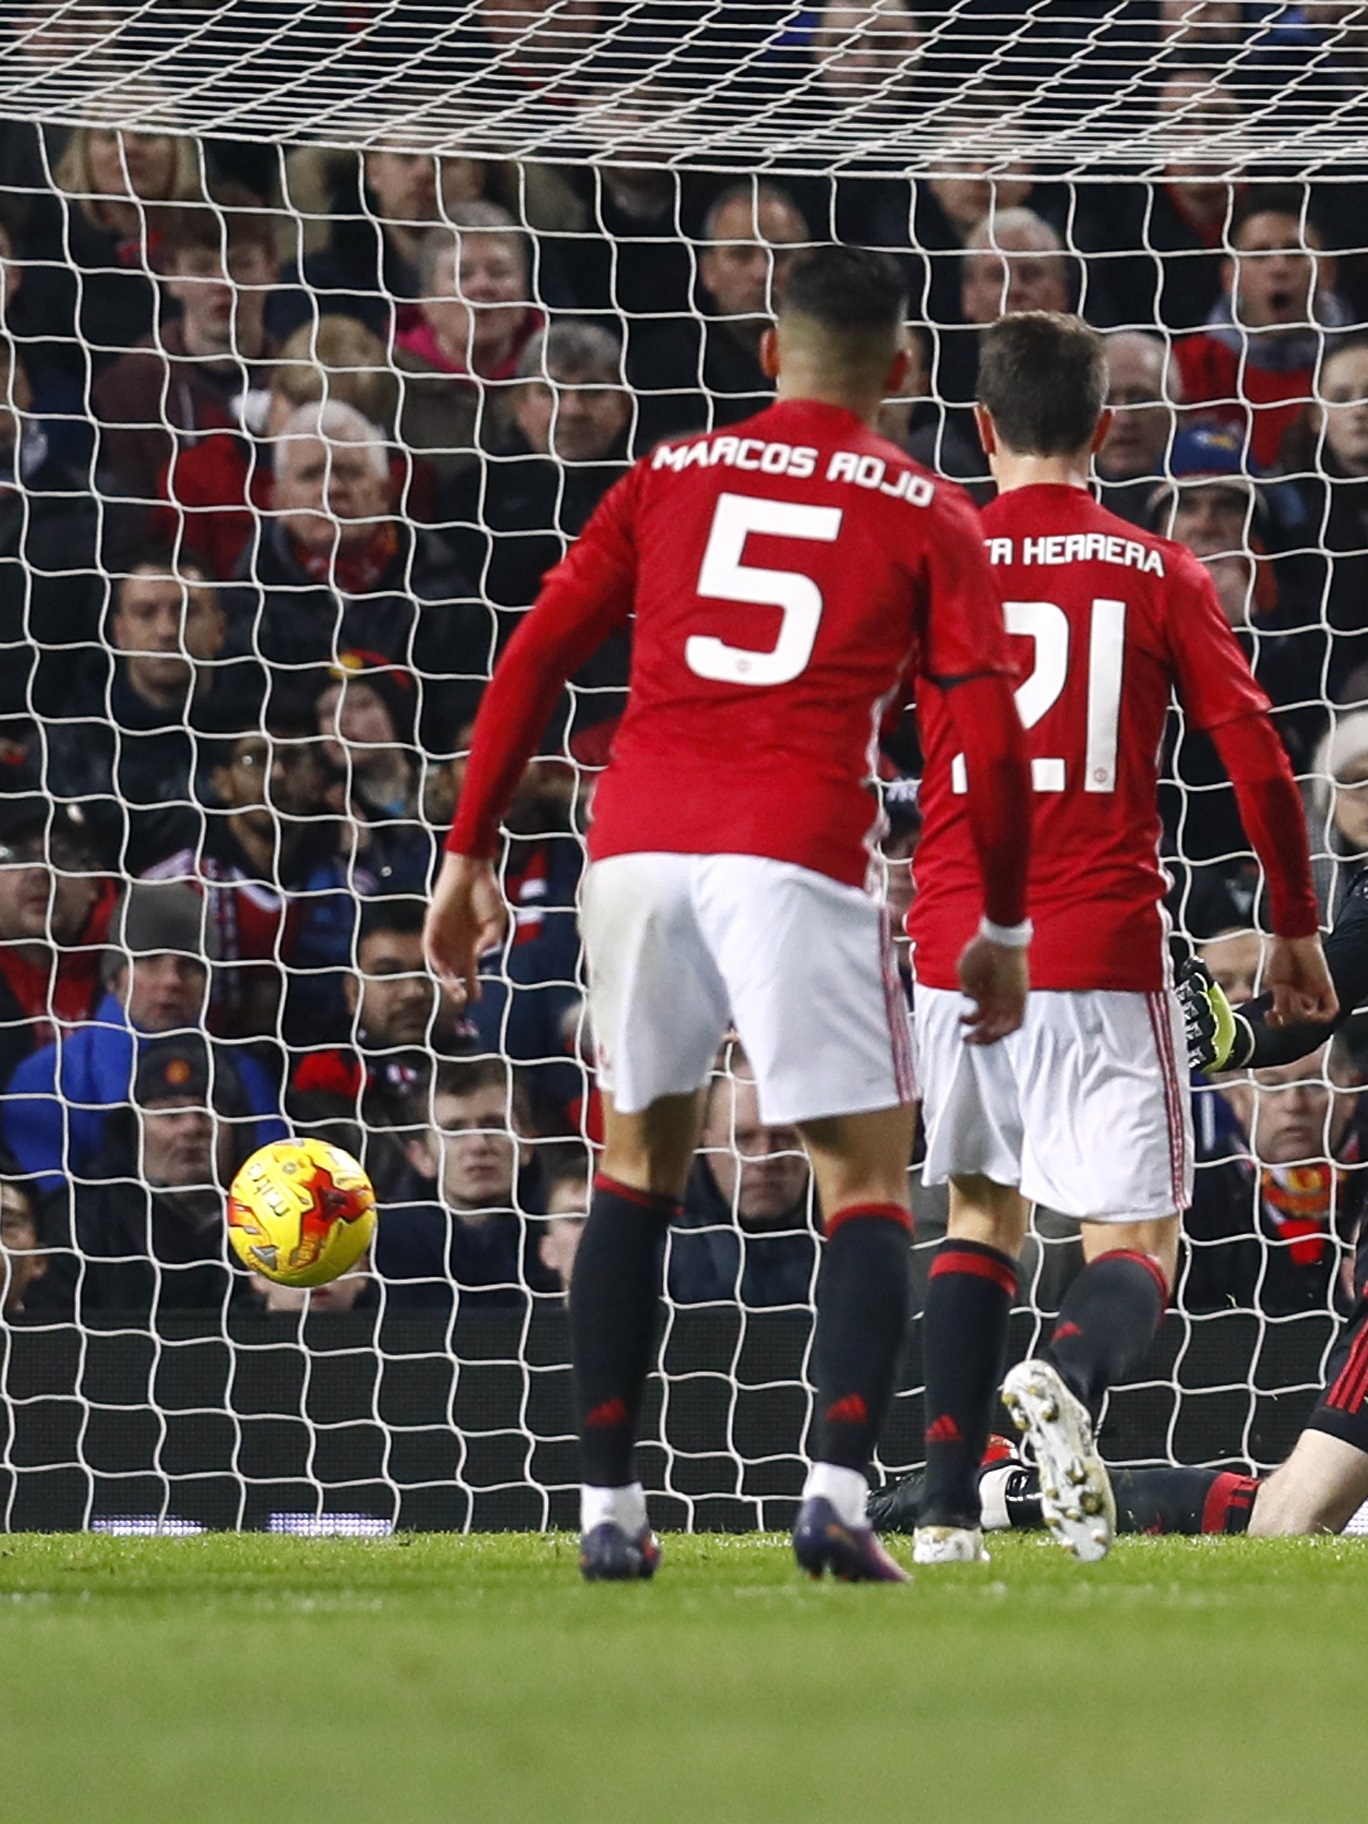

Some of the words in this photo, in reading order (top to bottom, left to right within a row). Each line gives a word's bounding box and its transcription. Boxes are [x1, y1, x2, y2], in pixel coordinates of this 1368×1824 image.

[652, 435, 818, 478] MARCOS
[826, 450, 935, 508] ROJO
[685, 493, 842, 686] 5
[1023, 532, 1165, 578] HERRERA
